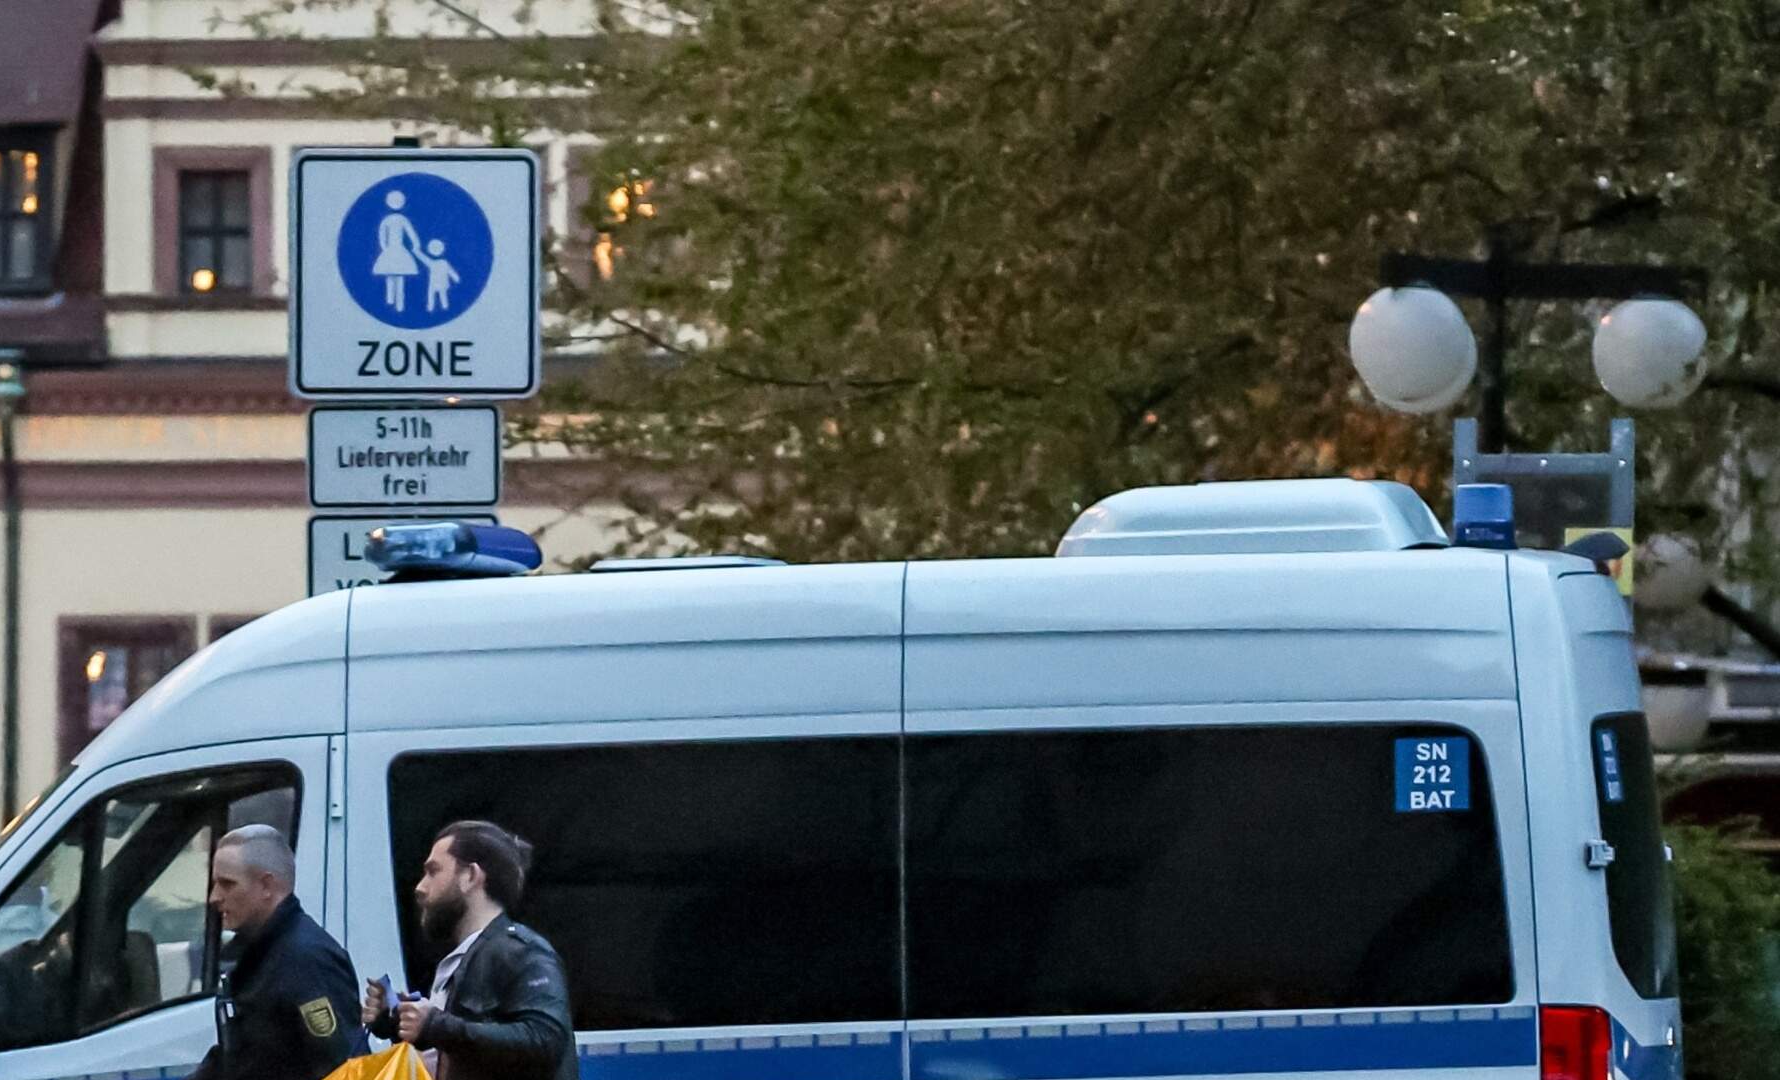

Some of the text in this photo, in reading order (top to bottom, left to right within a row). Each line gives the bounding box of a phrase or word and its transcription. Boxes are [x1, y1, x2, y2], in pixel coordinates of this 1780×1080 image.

[357, 340, 474, 377] ZONE
[376, 416, 433, 439] 5-11h
[337, 444, 470, 468] Lieferverkehr
[382, 473, 428, 496] frei
[1415, 742, 1448, 761] SN
[1413, 764, 1452, 784] 212
[1410, 789, 1456, 809] BAT
